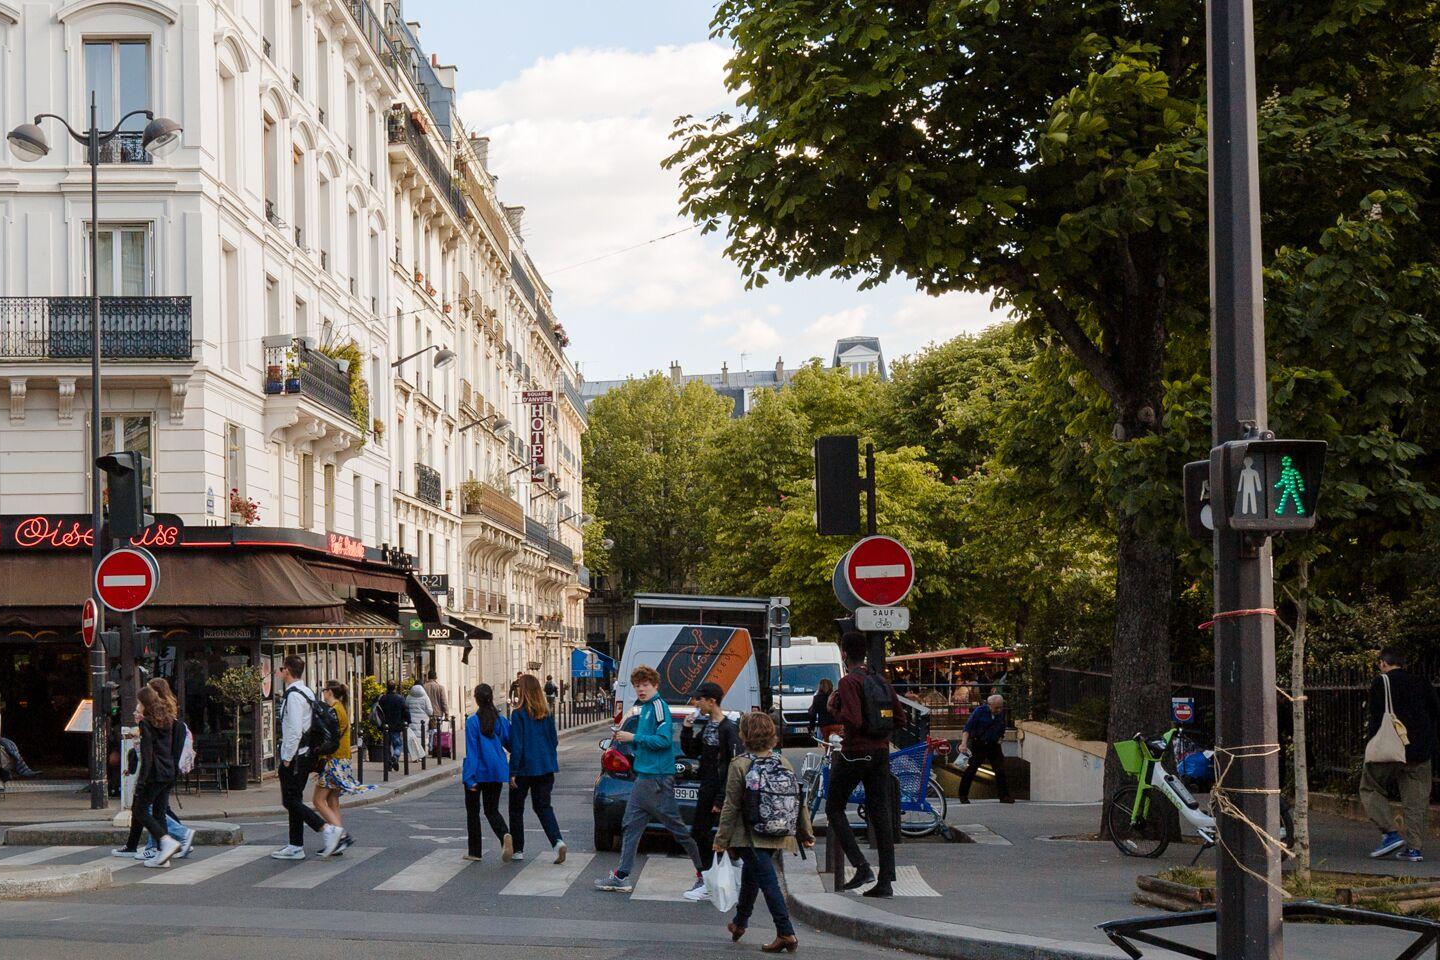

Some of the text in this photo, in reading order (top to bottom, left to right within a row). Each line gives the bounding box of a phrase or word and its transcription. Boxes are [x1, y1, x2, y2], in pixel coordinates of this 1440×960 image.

[15, 516, 179, 547] Oiseux
[421, 575, 442, 587] R-21
[427, 629, 450, 638] LAR-21
